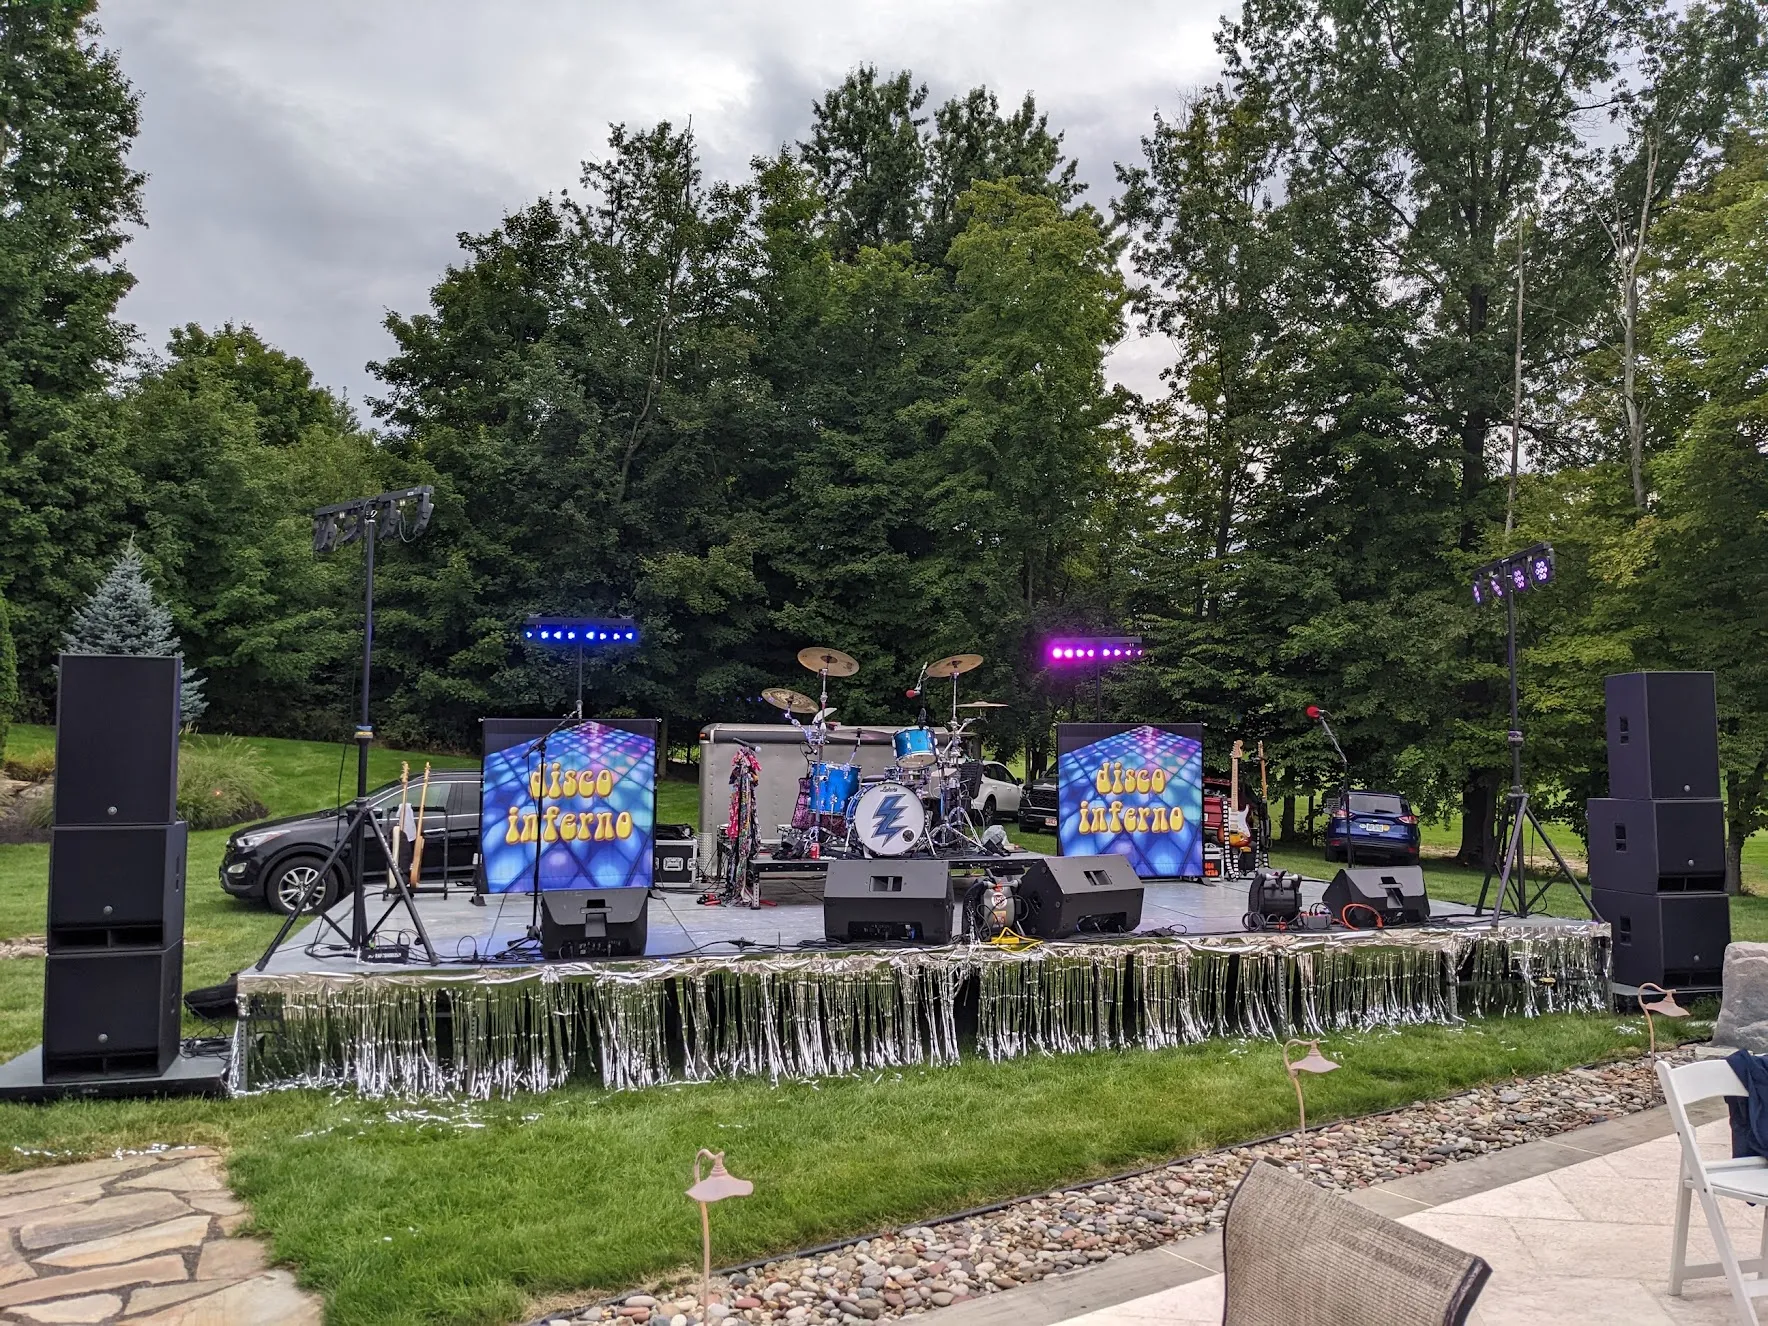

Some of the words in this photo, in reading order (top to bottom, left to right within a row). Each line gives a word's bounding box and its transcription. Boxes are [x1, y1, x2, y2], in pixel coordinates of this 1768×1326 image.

[530, 762, 613, 798] disco
[1097, 763, 1166, 794] disco
[505, 806, 633, 844] inferno
[1079, 801, 1184, 834] inferno
